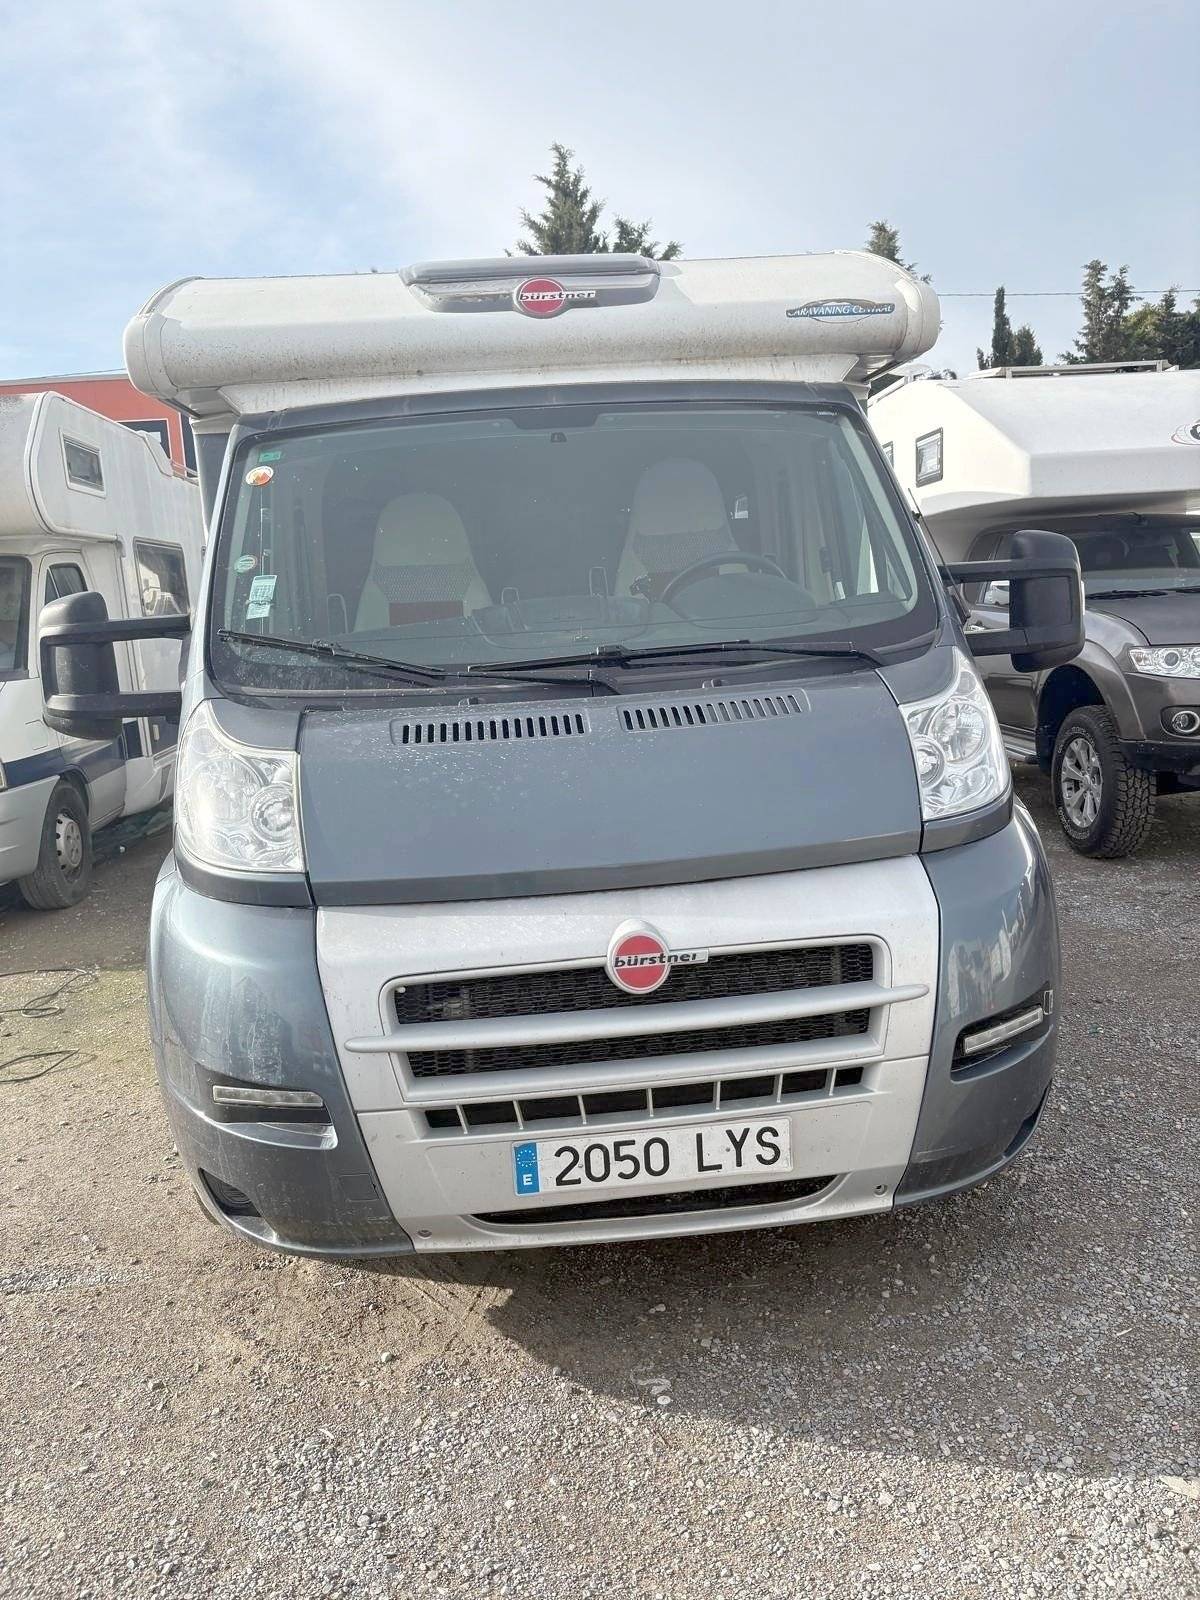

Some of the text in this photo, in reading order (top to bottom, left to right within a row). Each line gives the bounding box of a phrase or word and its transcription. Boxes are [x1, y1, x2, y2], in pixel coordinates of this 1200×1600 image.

[520, 291, 595, 301] bürstner
[852, 303, 892, 314] CETRAL
[614, 952, 697, 968] bürstner
[522, 1126, 781, 1187] E 2050 LYS
